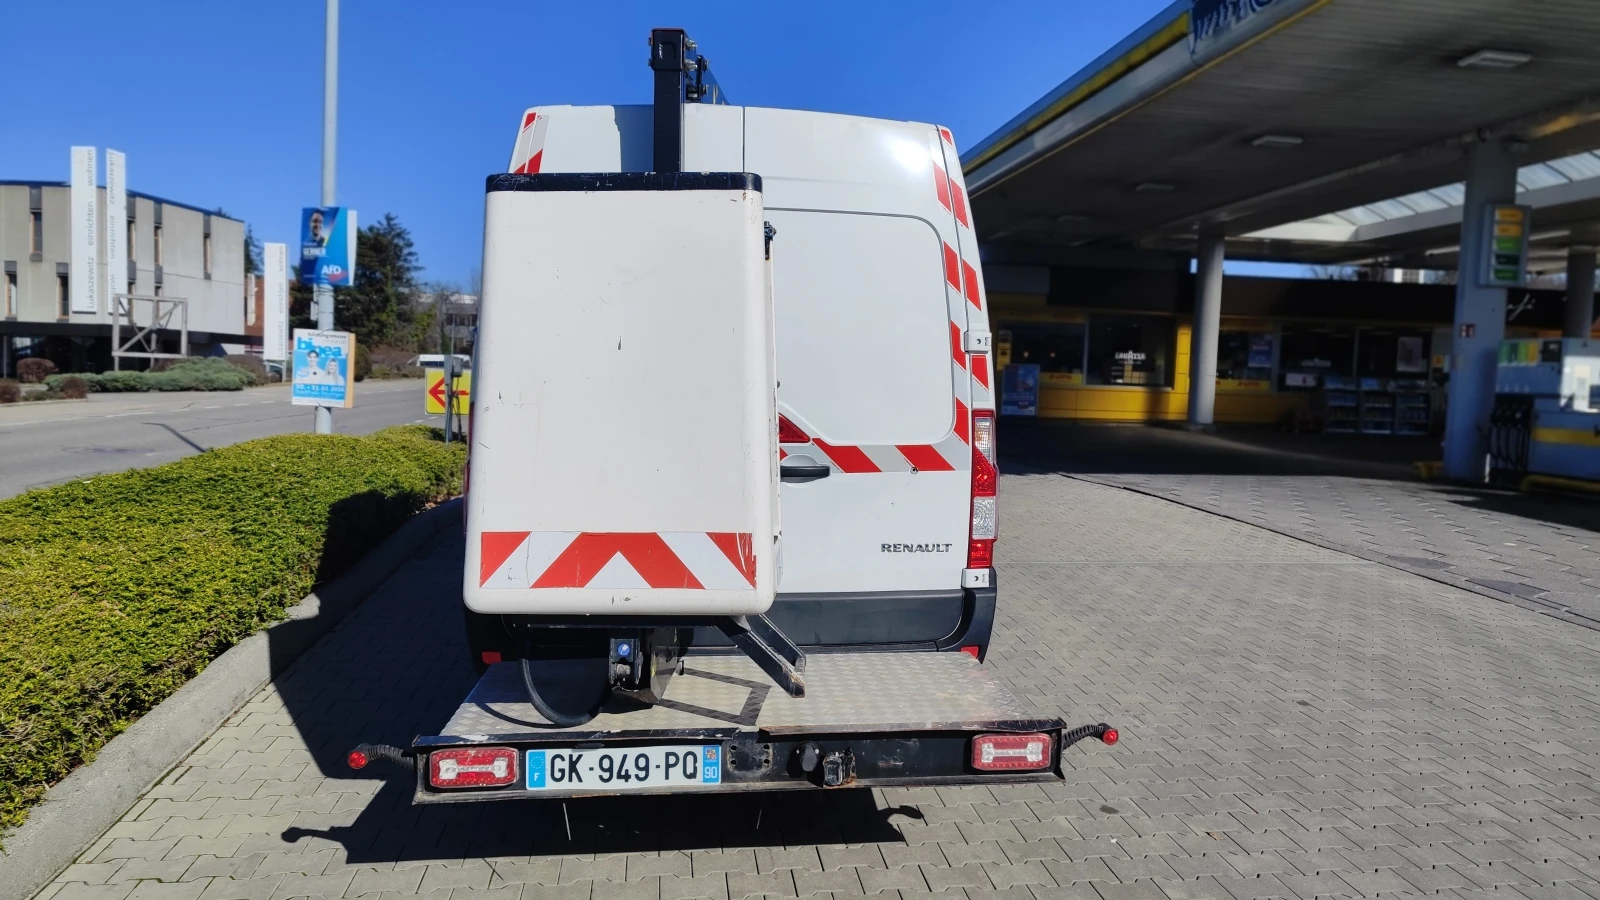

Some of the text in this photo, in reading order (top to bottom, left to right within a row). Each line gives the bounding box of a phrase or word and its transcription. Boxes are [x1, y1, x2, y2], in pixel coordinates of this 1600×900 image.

[85, 149, 94, 187] wohnen
[85, 201, 94, 246] einrichten
[86, 256, 95, 309] Lukaszewitz
[321, 264, 341, 275] AfD
[1114, 350, 1147, 360] LAVAZZA
[880, 543, 953, 553] RENAULT
[533, 751, 718, 783] F GK-949-PQ 90
